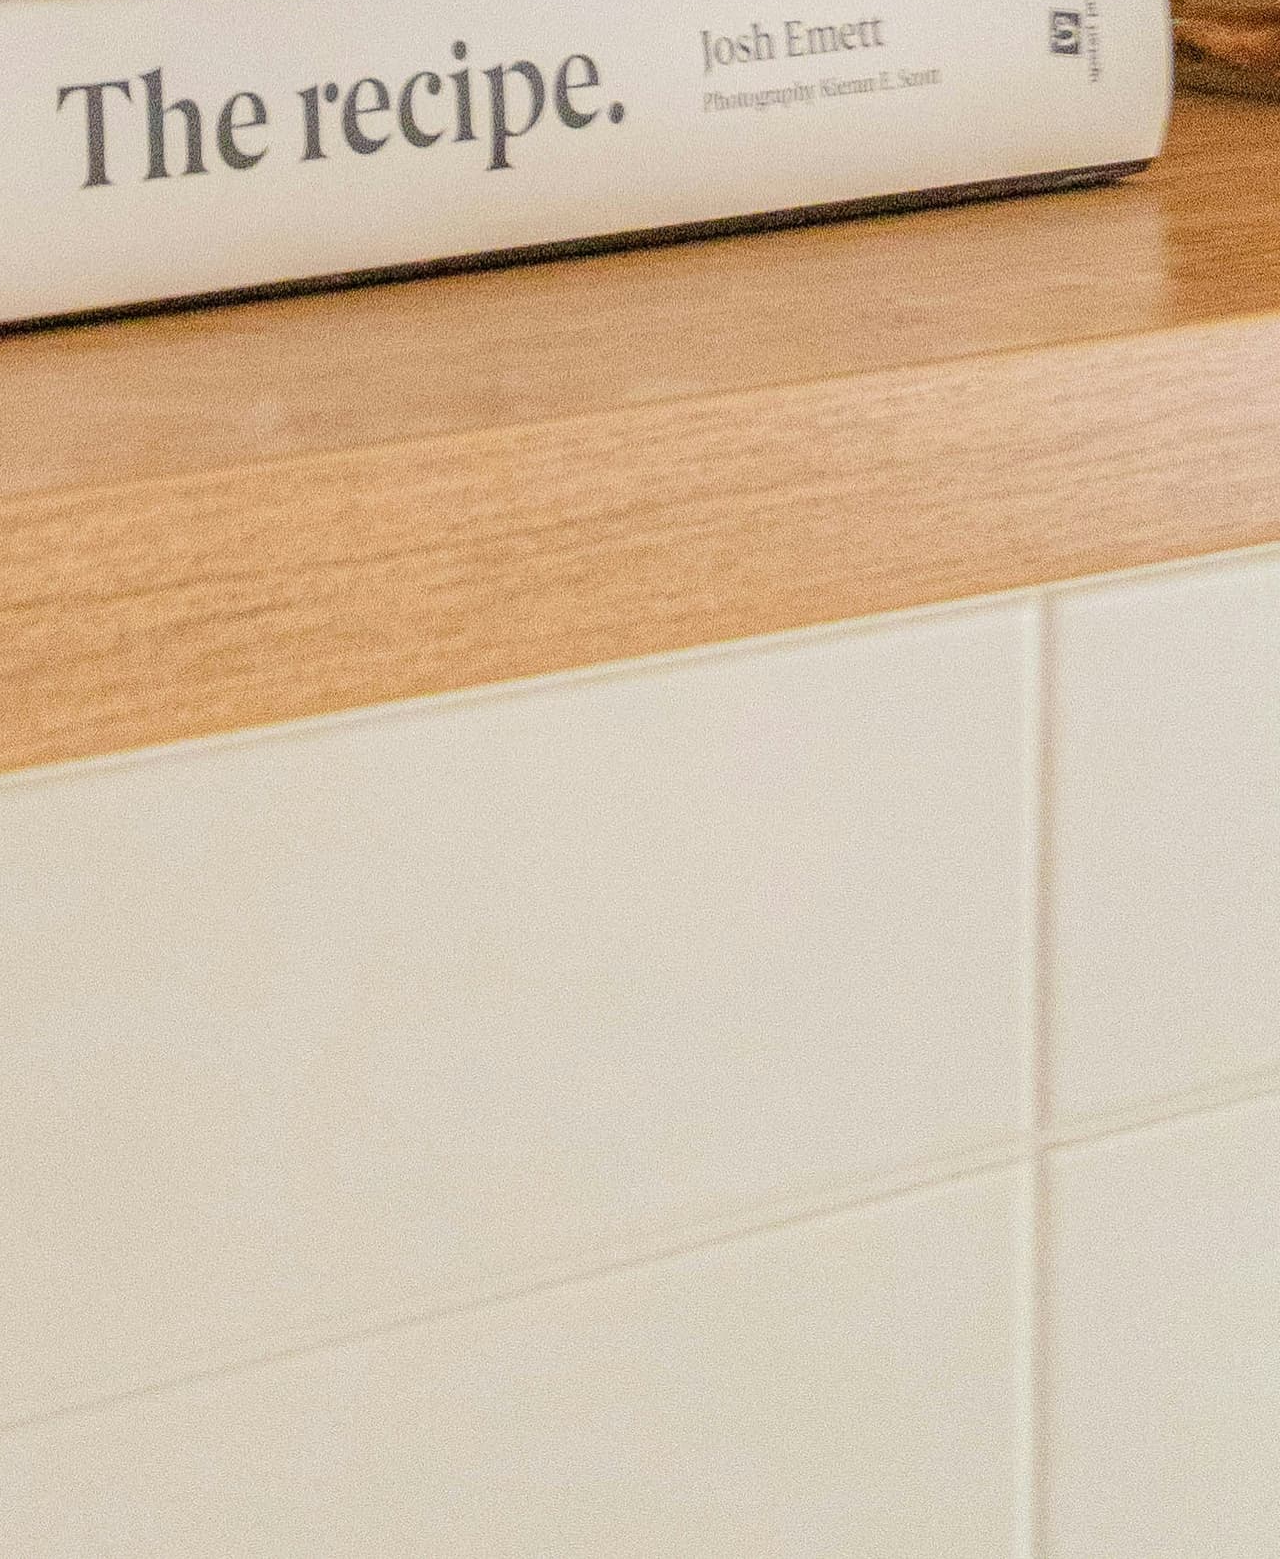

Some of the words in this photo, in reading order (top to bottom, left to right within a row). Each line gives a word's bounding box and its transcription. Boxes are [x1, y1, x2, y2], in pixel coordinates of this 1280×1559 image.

[700, 23, 775, 74] Josh
[783, 18, 885, 57] Emett
[56, 67, 268, 189] The
[297, 40, 626, 171] recipe.
[703, 81, 815, 113] Photography
